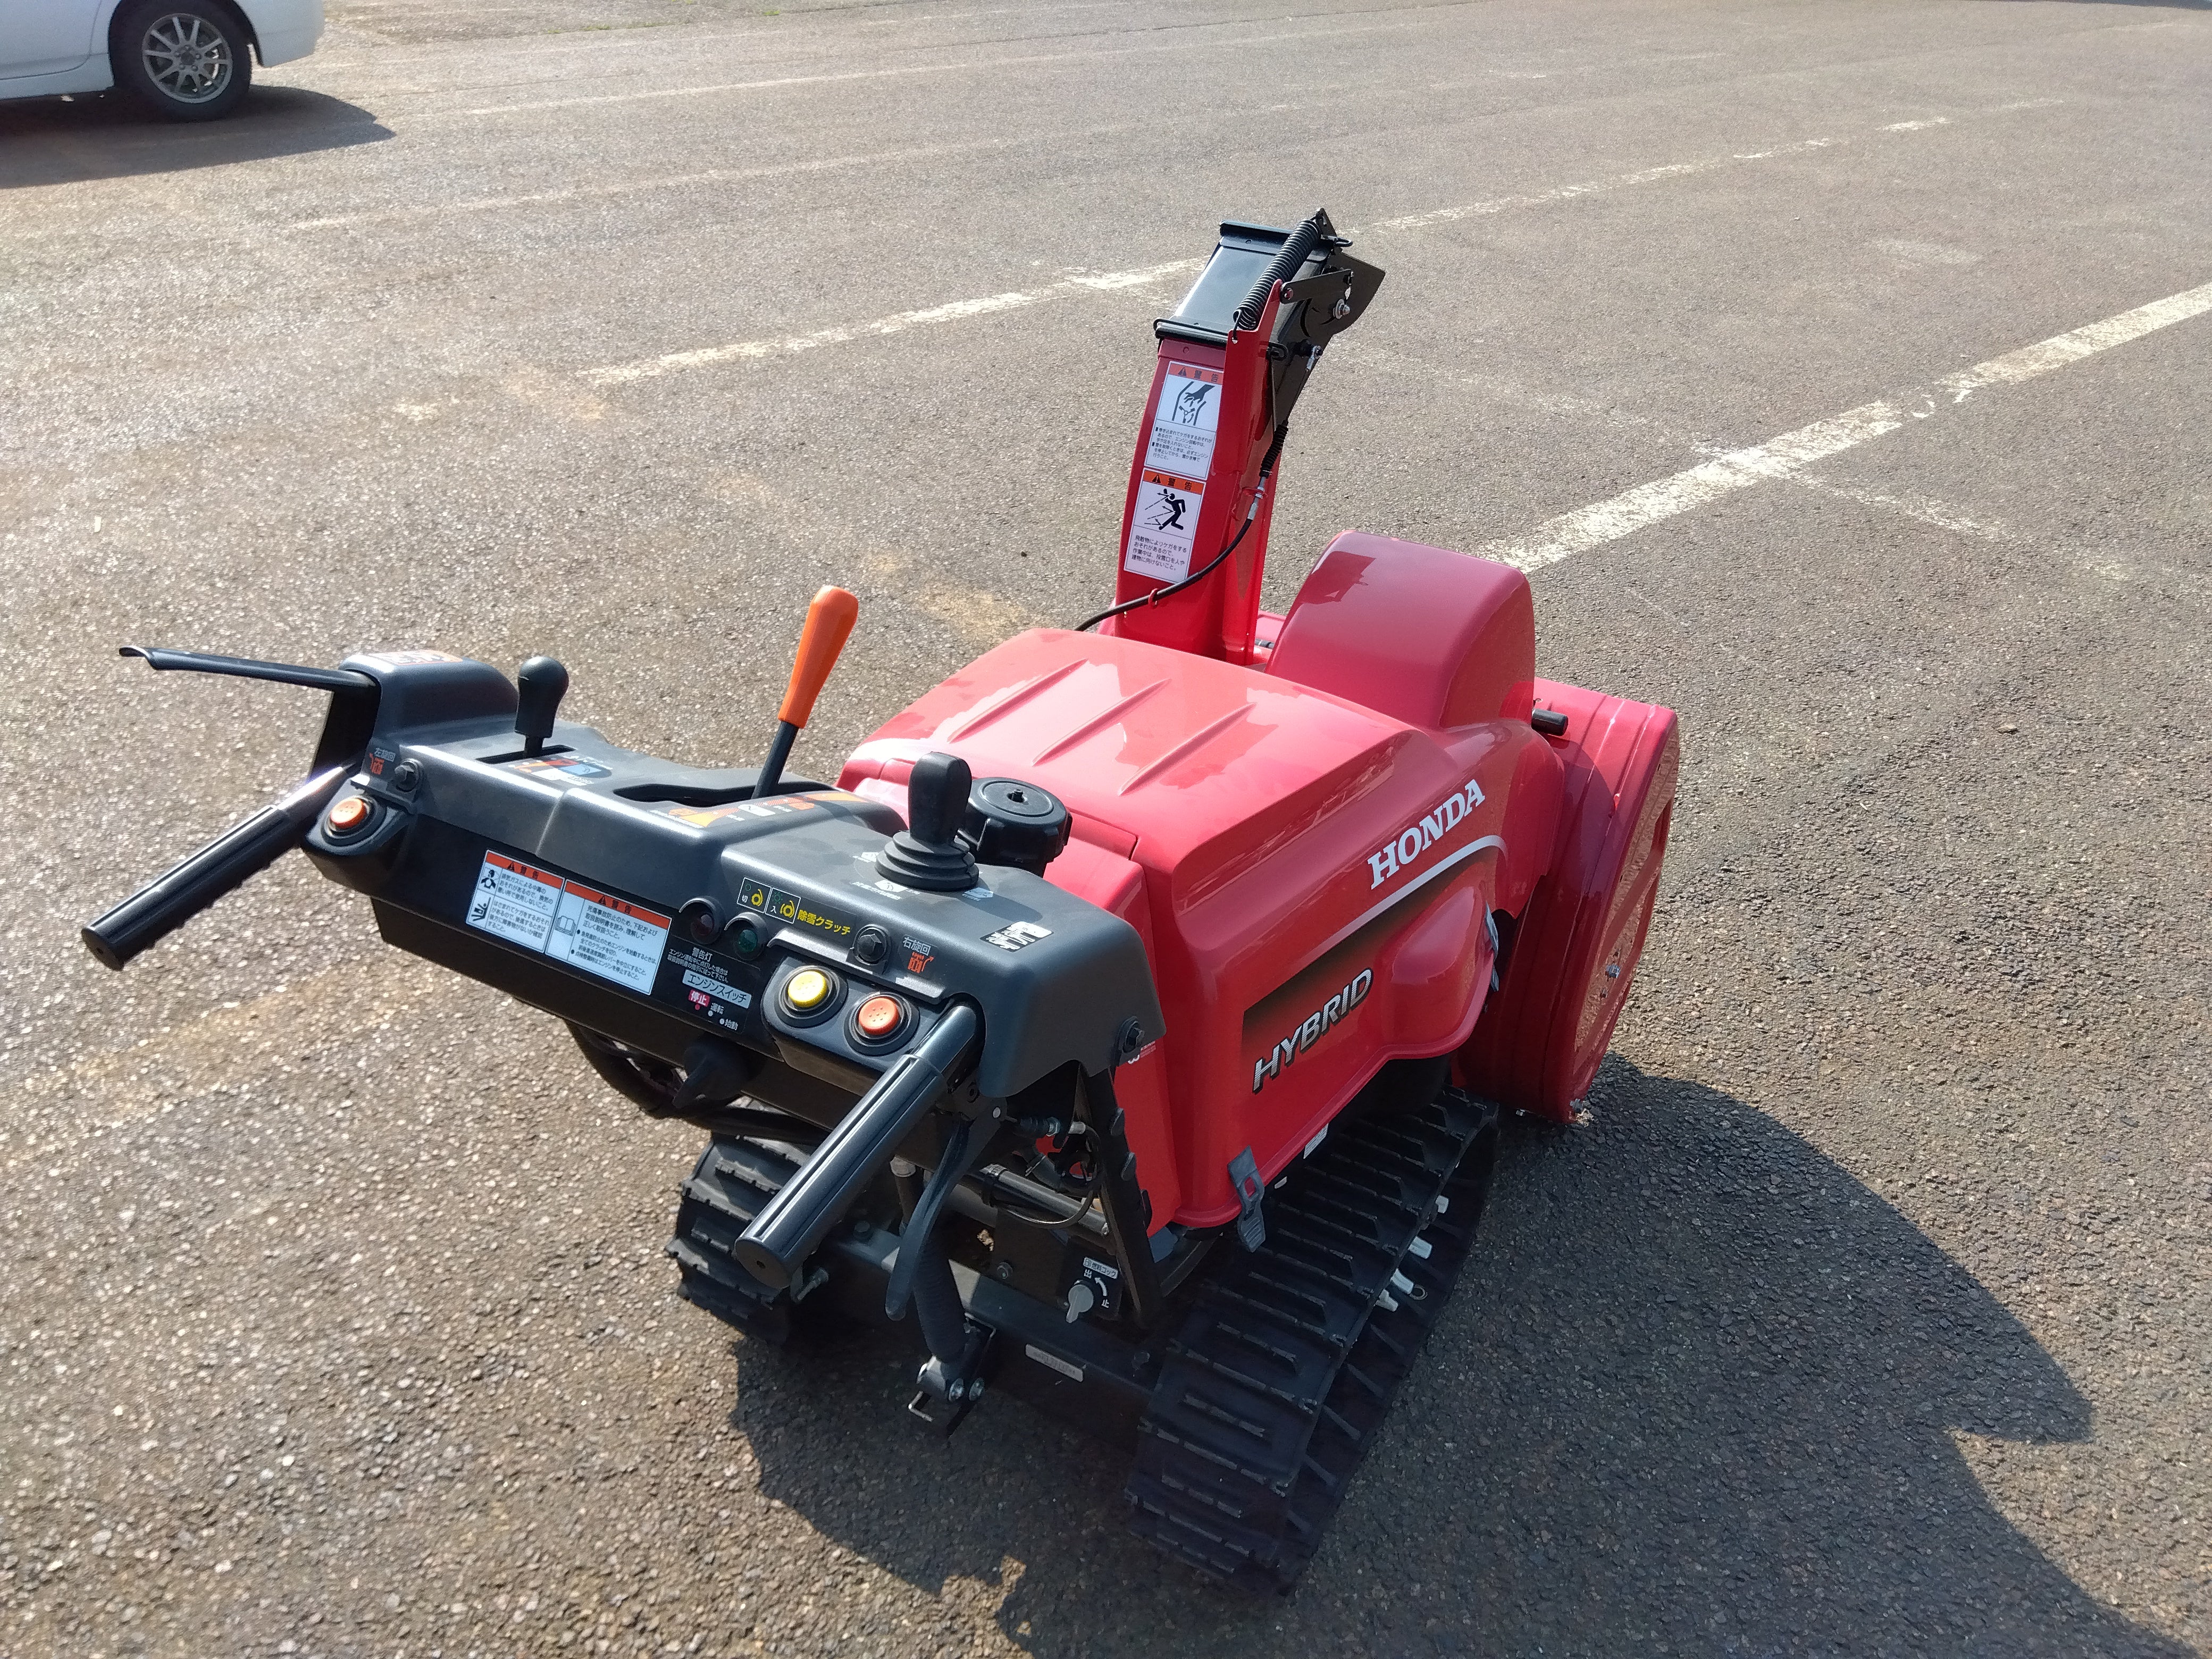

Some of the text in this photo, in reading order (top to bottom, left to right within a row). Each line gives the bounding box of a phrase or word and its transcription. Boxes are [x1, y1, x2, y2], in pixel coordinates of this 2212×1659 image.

[1194, 370, 1218, 382] 警告
[1168, 478, 1192, 491] 警告
[1368, 779, 1485, 890] HONDA
[611, 900, 632, 914] 警告
[797, 909, 851, 935] 除雪クラッチ
[902, 936, 931, 956] 右旋回
[692, 948, 713, 962] 警告灯
[688, 974, 747, 1003] エンジンスイッチ
[691, 991, 707, 1006] 停止
[710, 1002, 724, 1015] 運転
[725, 1019, 738, 1030] 始動
[1252, 966, 1375, 1094] HYBRID
[1084, 1269, 1092, 1279] 出
[1101, 1298, 1110, 1308] 止
